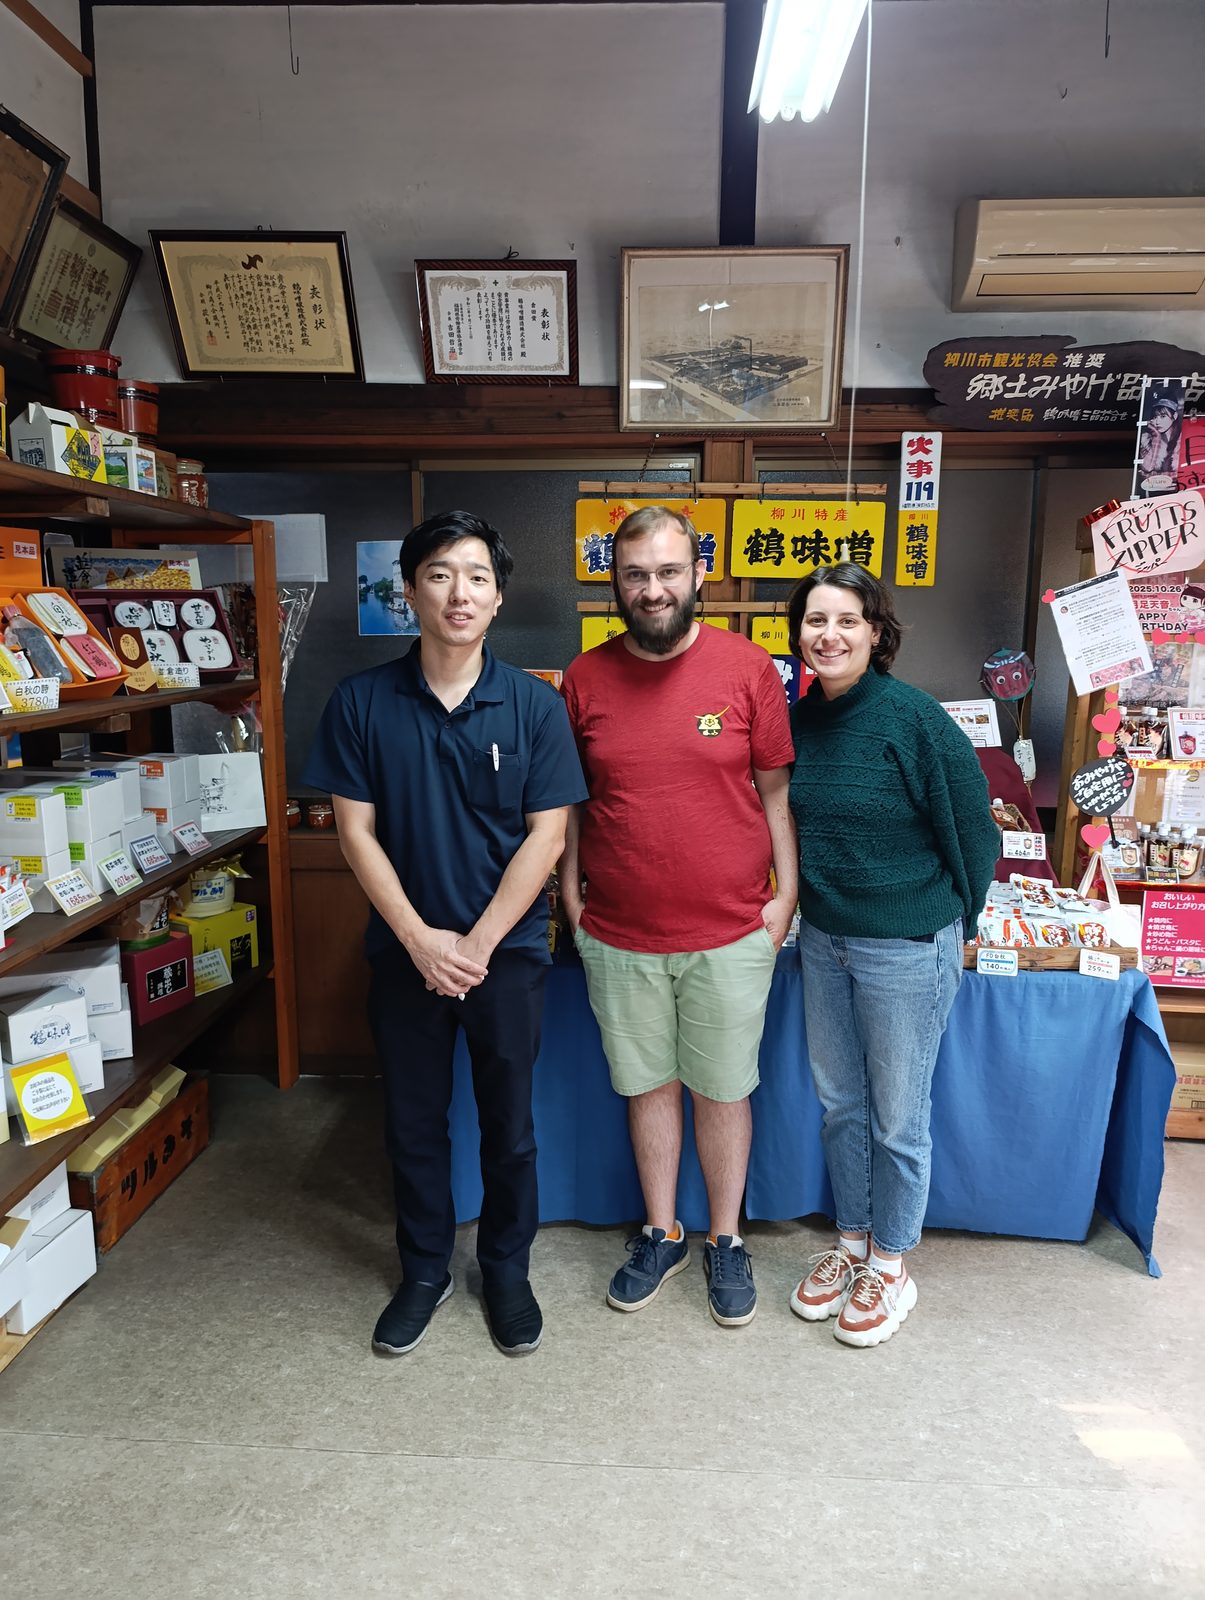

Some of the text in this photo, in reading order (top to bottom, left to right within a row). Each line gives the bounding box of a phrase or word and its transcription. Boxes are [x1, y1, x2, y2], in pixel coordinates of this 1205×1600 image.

[309, 284, 327, 331] 表彰状
[541, 308, 551, 341] 表彰状
[943, 352, 1107, 368] 柳川市観光協会 推奨
[987, 407, 1034, 423] 推奨品
[906, 436, 934, 479] 火事
[905, 481, 934, 501] 119
[770, 507, 849, 522] 柳川特産
[1100, 499, 1198, 550] FRUITS
[15, 544, 36, 556] 見本品
[743, 526, 875, 567] 鶴味噌
[905, 523, 930, 580] 鶴味噌
[1107, 521, 1199, 571] ZIPPER
[168, 559, 191, 567] 見本品
[1128, 585, 1182, 593] 2025.10.26
[1138, 612, 1168, 621] APPY
[1141, 622, 1189, 631] RTHDAY
[15, 683, 50, 697] 白秋の詩
[1071, 757, 1128, 791] おみやげや
[1073, 770, 1127, 804] ご自宅用に
[1163, 893, 1196, 901] おいしい
[1150, 901, 1205, 911] お召し上がり方
[1152, 938, 1202, 946] うどん・パスタに
[121, 1113, 193, 1202] ツルみそ
